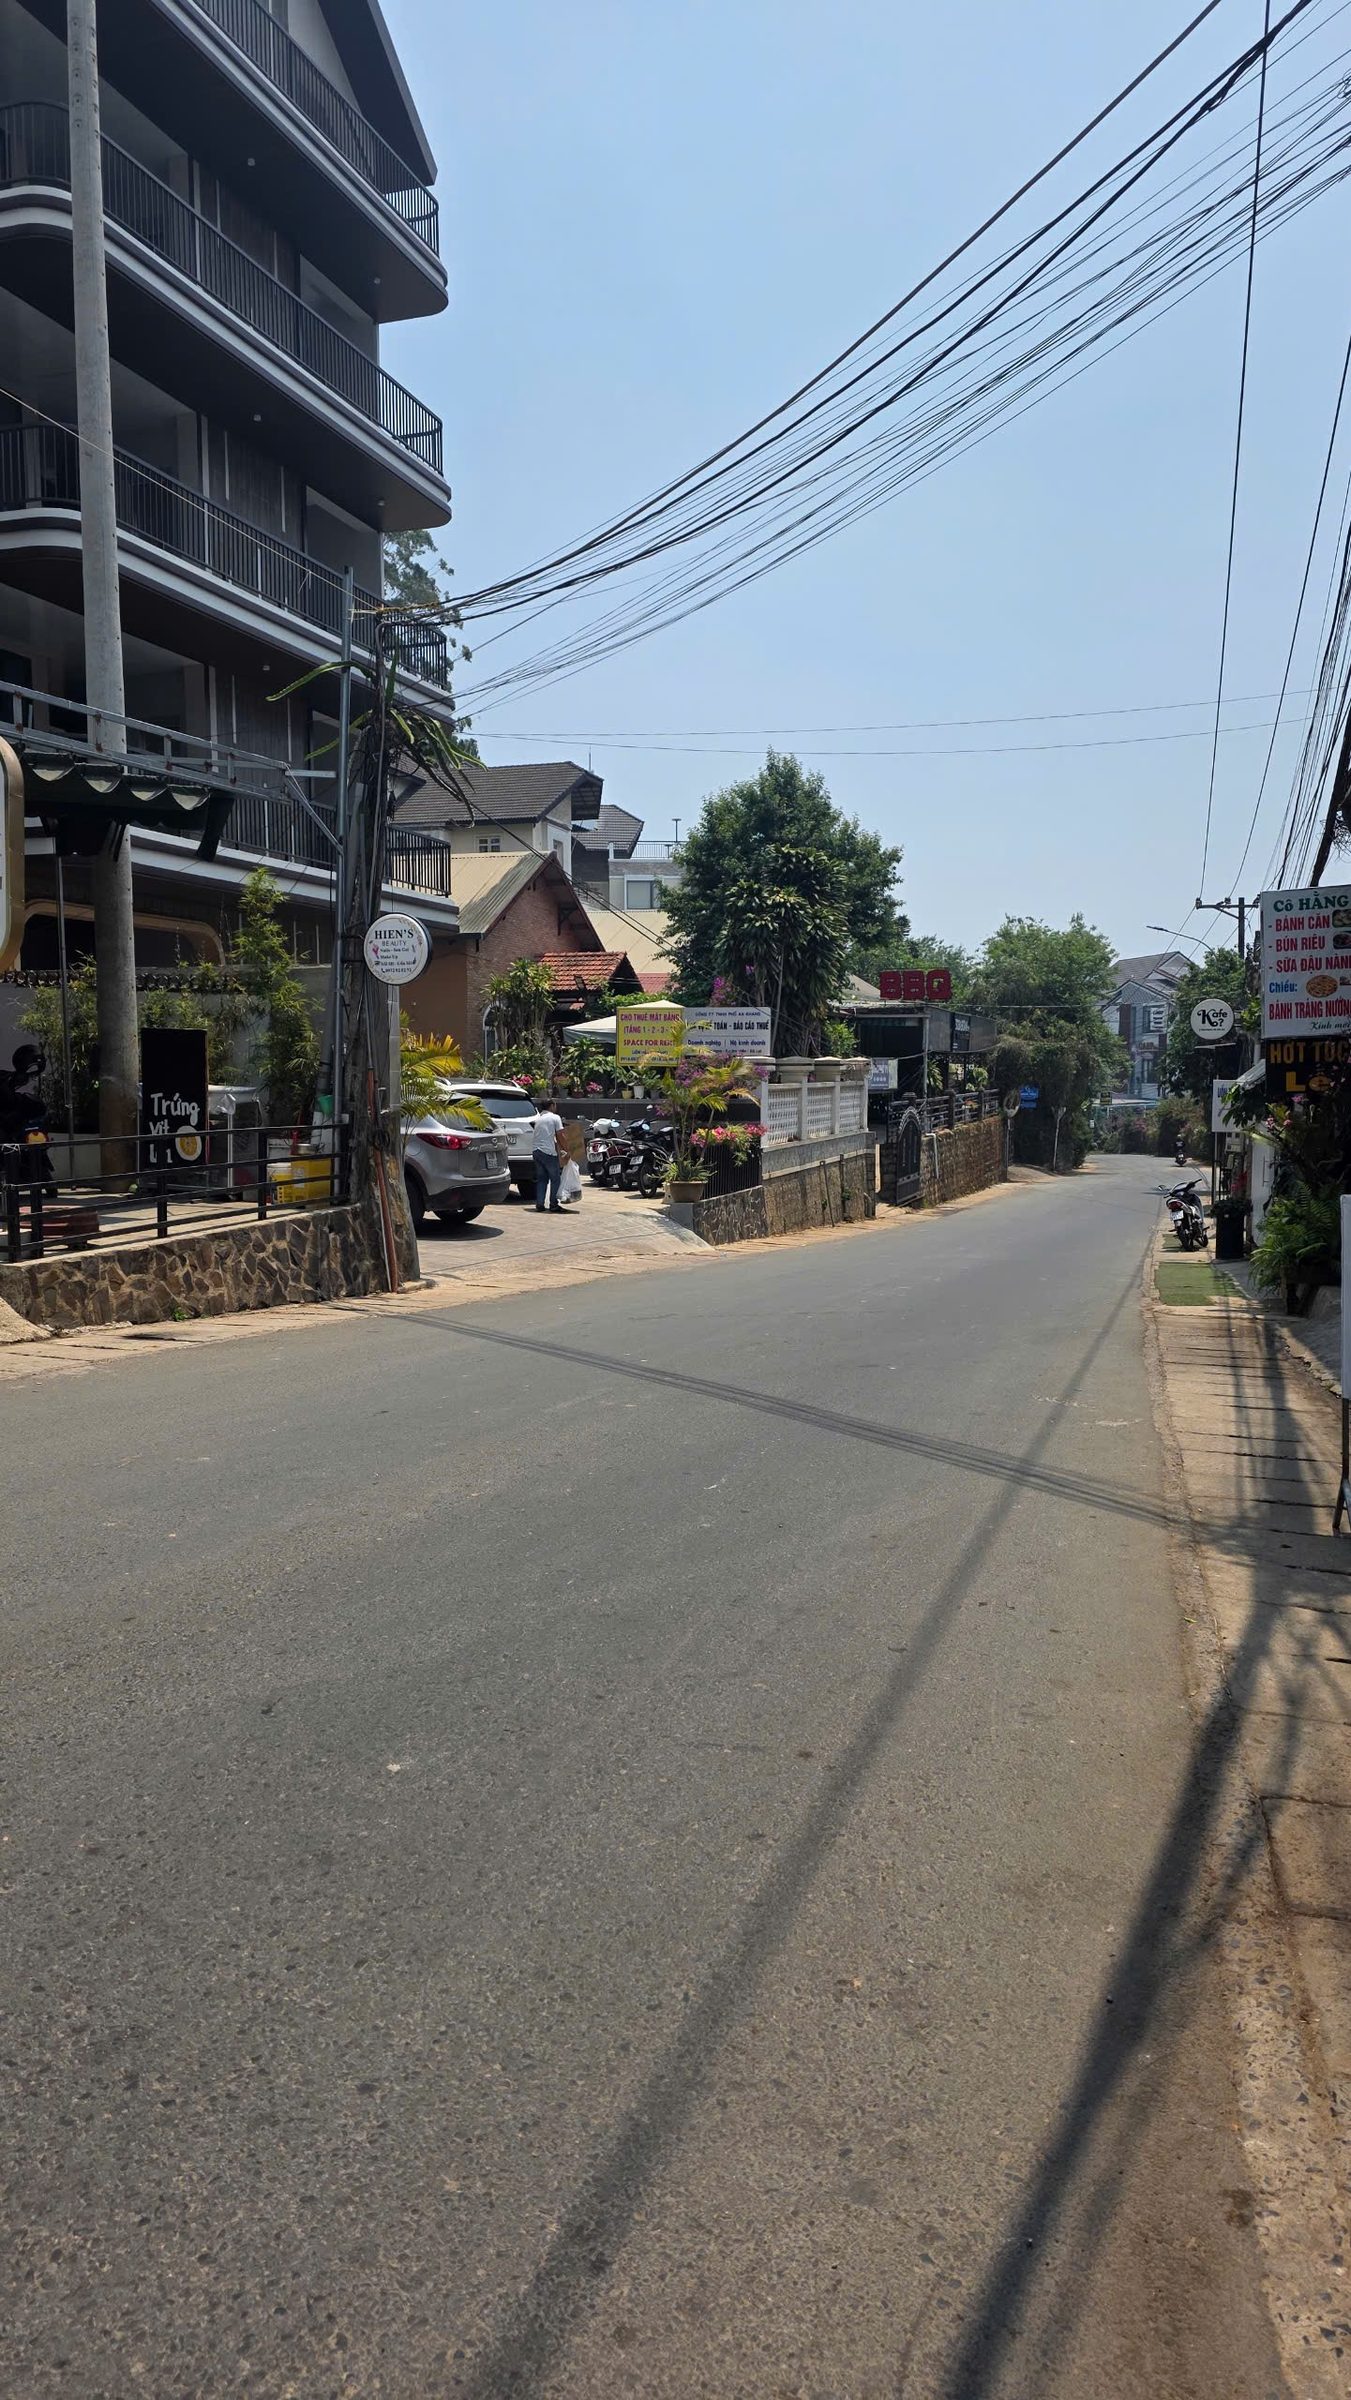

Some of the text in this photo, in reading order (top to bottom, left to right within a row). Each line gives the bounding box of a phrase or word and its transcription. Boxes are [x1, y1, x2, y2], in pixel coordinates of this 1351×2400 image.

[1273, 899, 1294, 912] Cô
[1275, 915, 1305, 932] BÁNH
[1276, 936, 1298, 952] BÚN
[1301, 934, 1326, 951] RIÊU
[1300, 955, 1322, 974] ĐẬU
[880, 969, 953, 1001] BBQ
[1269, 995, 1351, 1020] BÁNH TRÁNG NƯỚN
[714, 1020, 728, 1030] TOÁN
[733, 1020, 744, 1030] BÁO
[745, 1020, 755, 1030] CÁO
[624, 1039, 643, 1047] SPACE
[645, 1039, 657, 1047] FOR
[150, 1093, 200, 1126] Trứng
